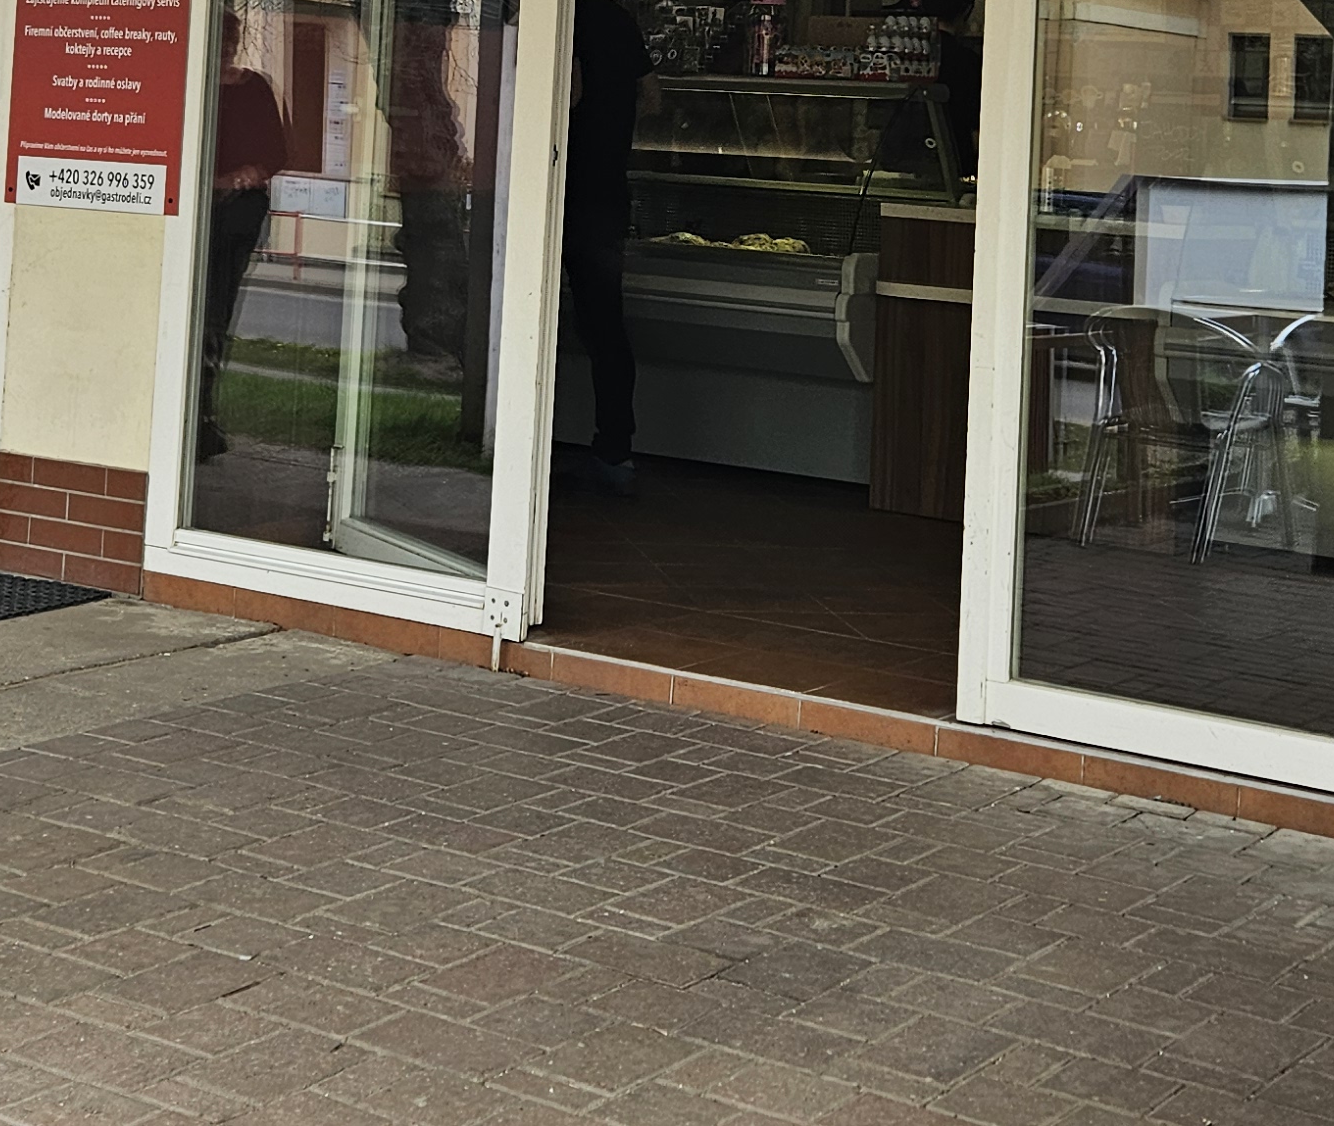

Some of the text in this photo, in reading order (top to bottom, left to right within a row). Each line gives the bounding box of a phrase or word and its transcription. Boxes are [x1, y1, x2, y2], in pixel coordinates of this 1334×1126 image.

[24, 25, 53, 37] Firemní
[54, 25, 99, 40] občerstvení,
[100, 27, 123, 39] coffee
[154, 30, 178, 44] rauty,
[65, 42, 132, 59] koktejly a recepce
[52, 74, 142, 93] Svatby a rodinné oslavy
[44, 107, 146, 126] Modelované dorty na přání
[49, 169, 155, 190] +420 326 996 359
[50, 186, 152, 205] objednavky@gastrodeli.cz
